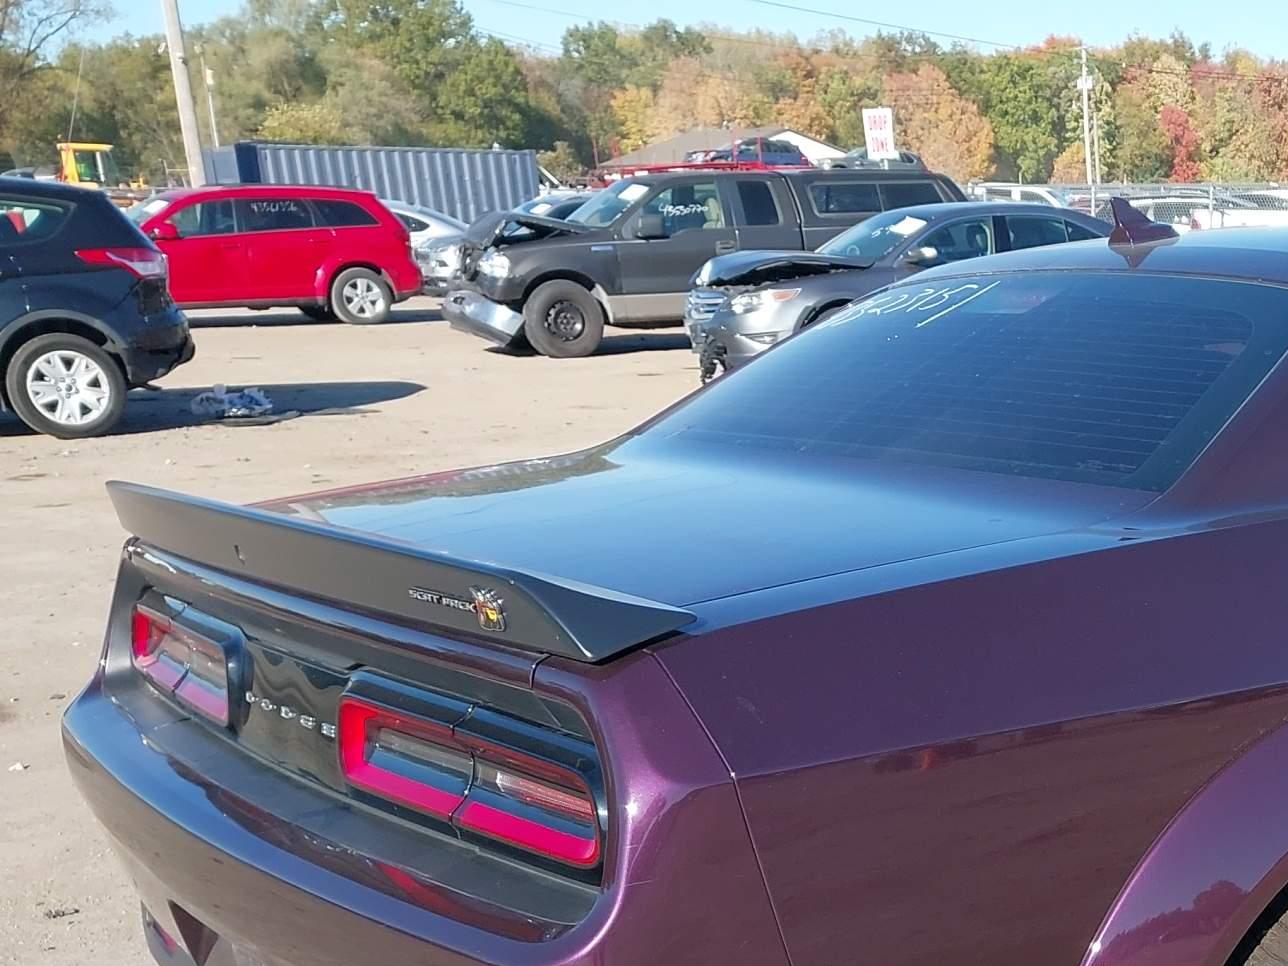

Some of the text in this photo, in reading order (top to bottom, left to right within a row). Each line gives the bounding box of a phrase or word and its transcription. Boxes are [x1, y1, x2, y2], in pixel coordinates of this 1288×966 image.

[408, 589, 477, 614] SCAT PACK
[246, 690, 336, 738] DODGE
